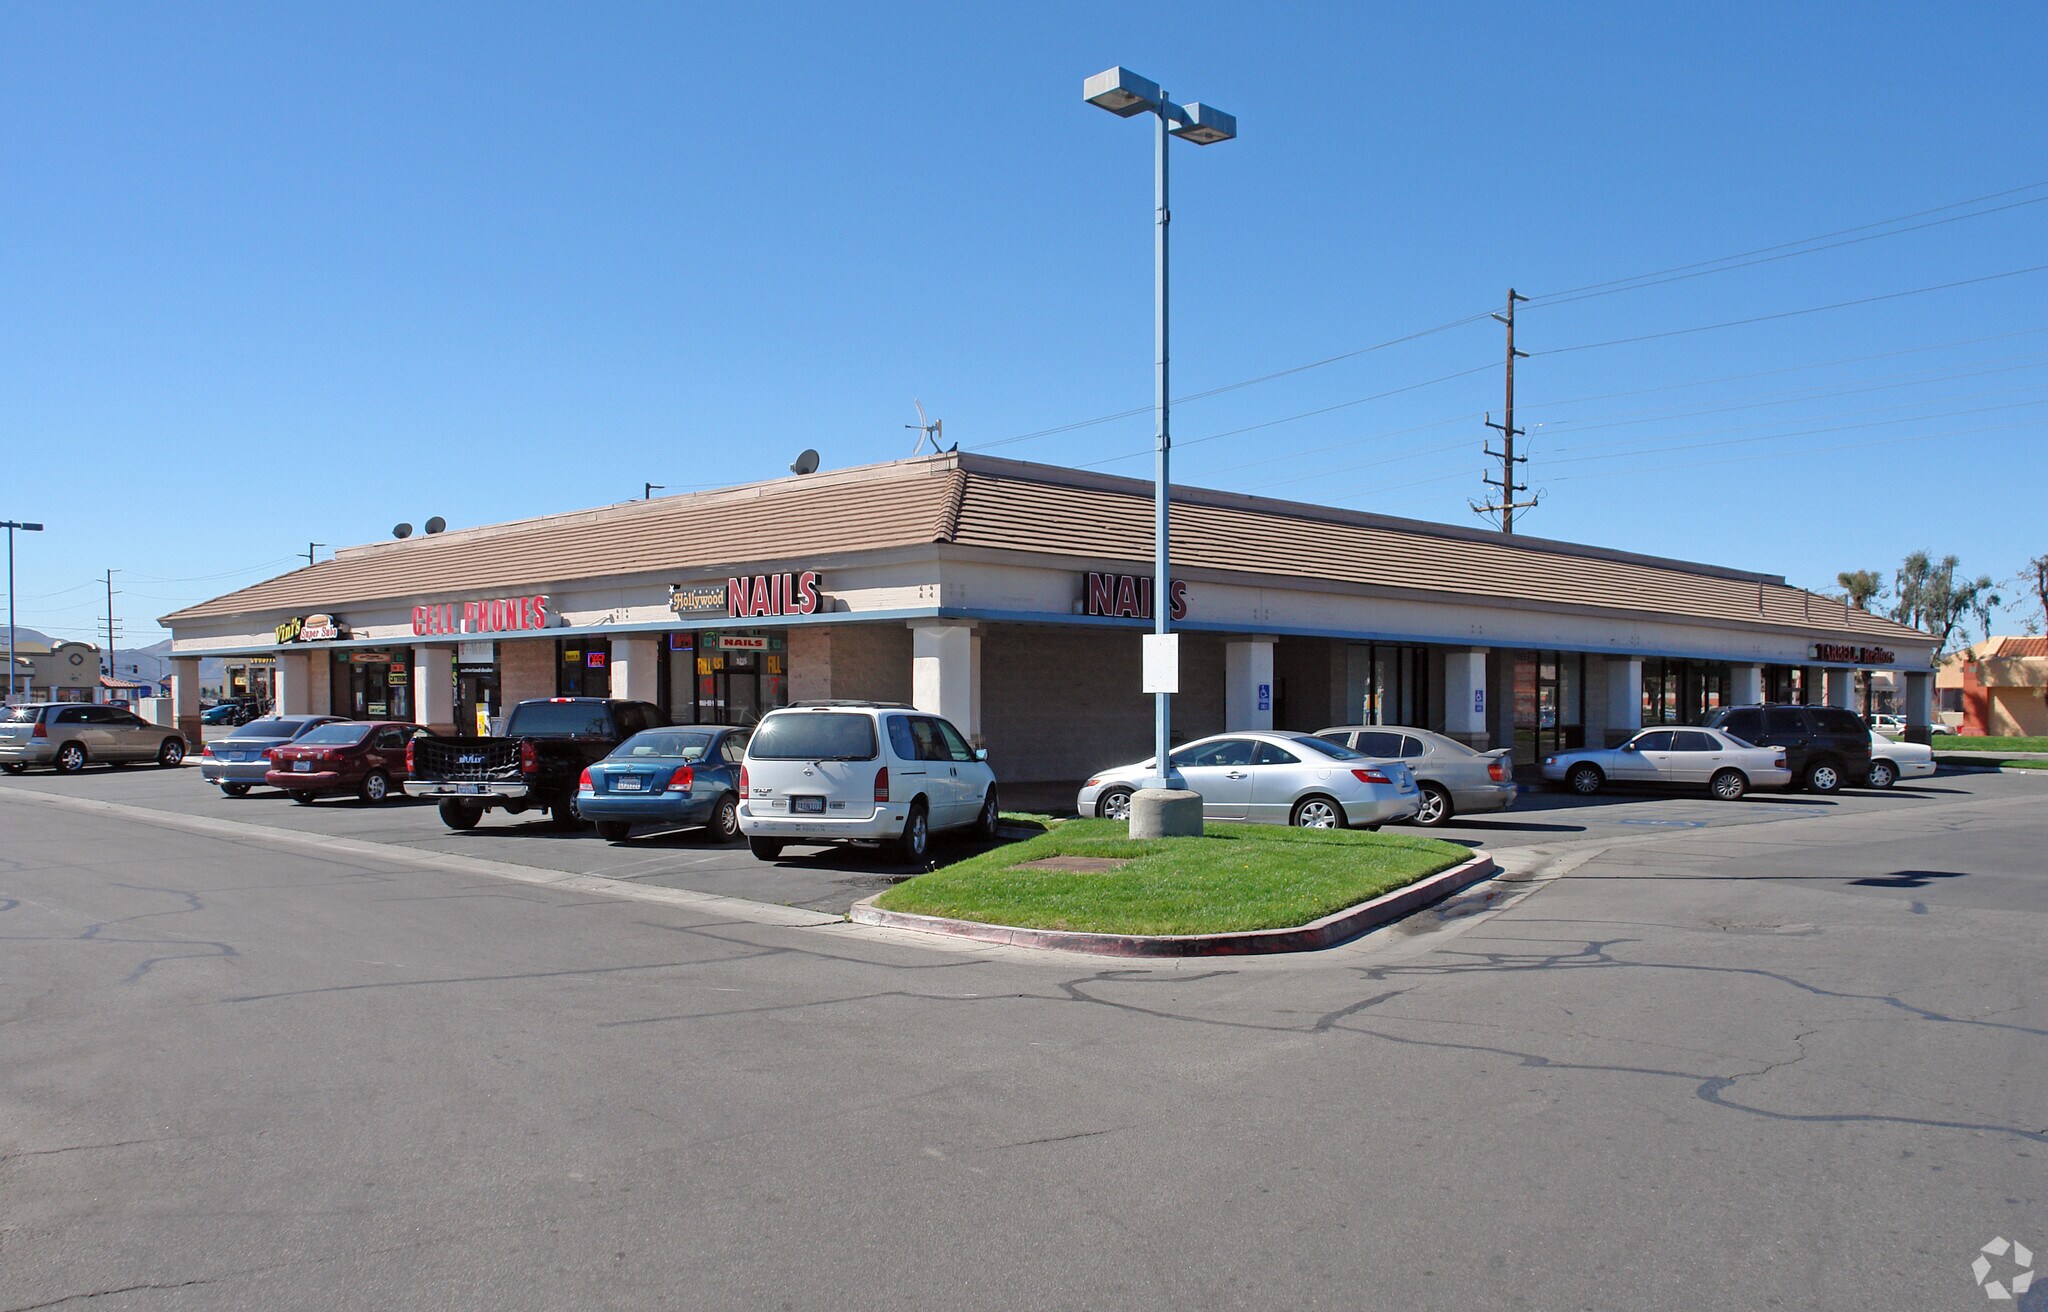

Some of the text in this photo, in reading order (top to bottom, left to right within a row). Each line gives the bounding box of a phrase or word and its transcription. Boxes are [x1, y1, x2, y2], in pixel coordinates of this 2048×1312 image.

[673, 570, 818, 618] Hollywood NAILS
[1089, 572, 1187, 621] NAIS
[412, 594, 546, 636] CELL PHONES
[274, 617, 301, 644] Vini's
[724, 639, 763, 647] NAILS
[697, 657, 712, 675] FULL
[767, 655, 782, 674] FILL
[459, 754, 482, 764] BULLY
